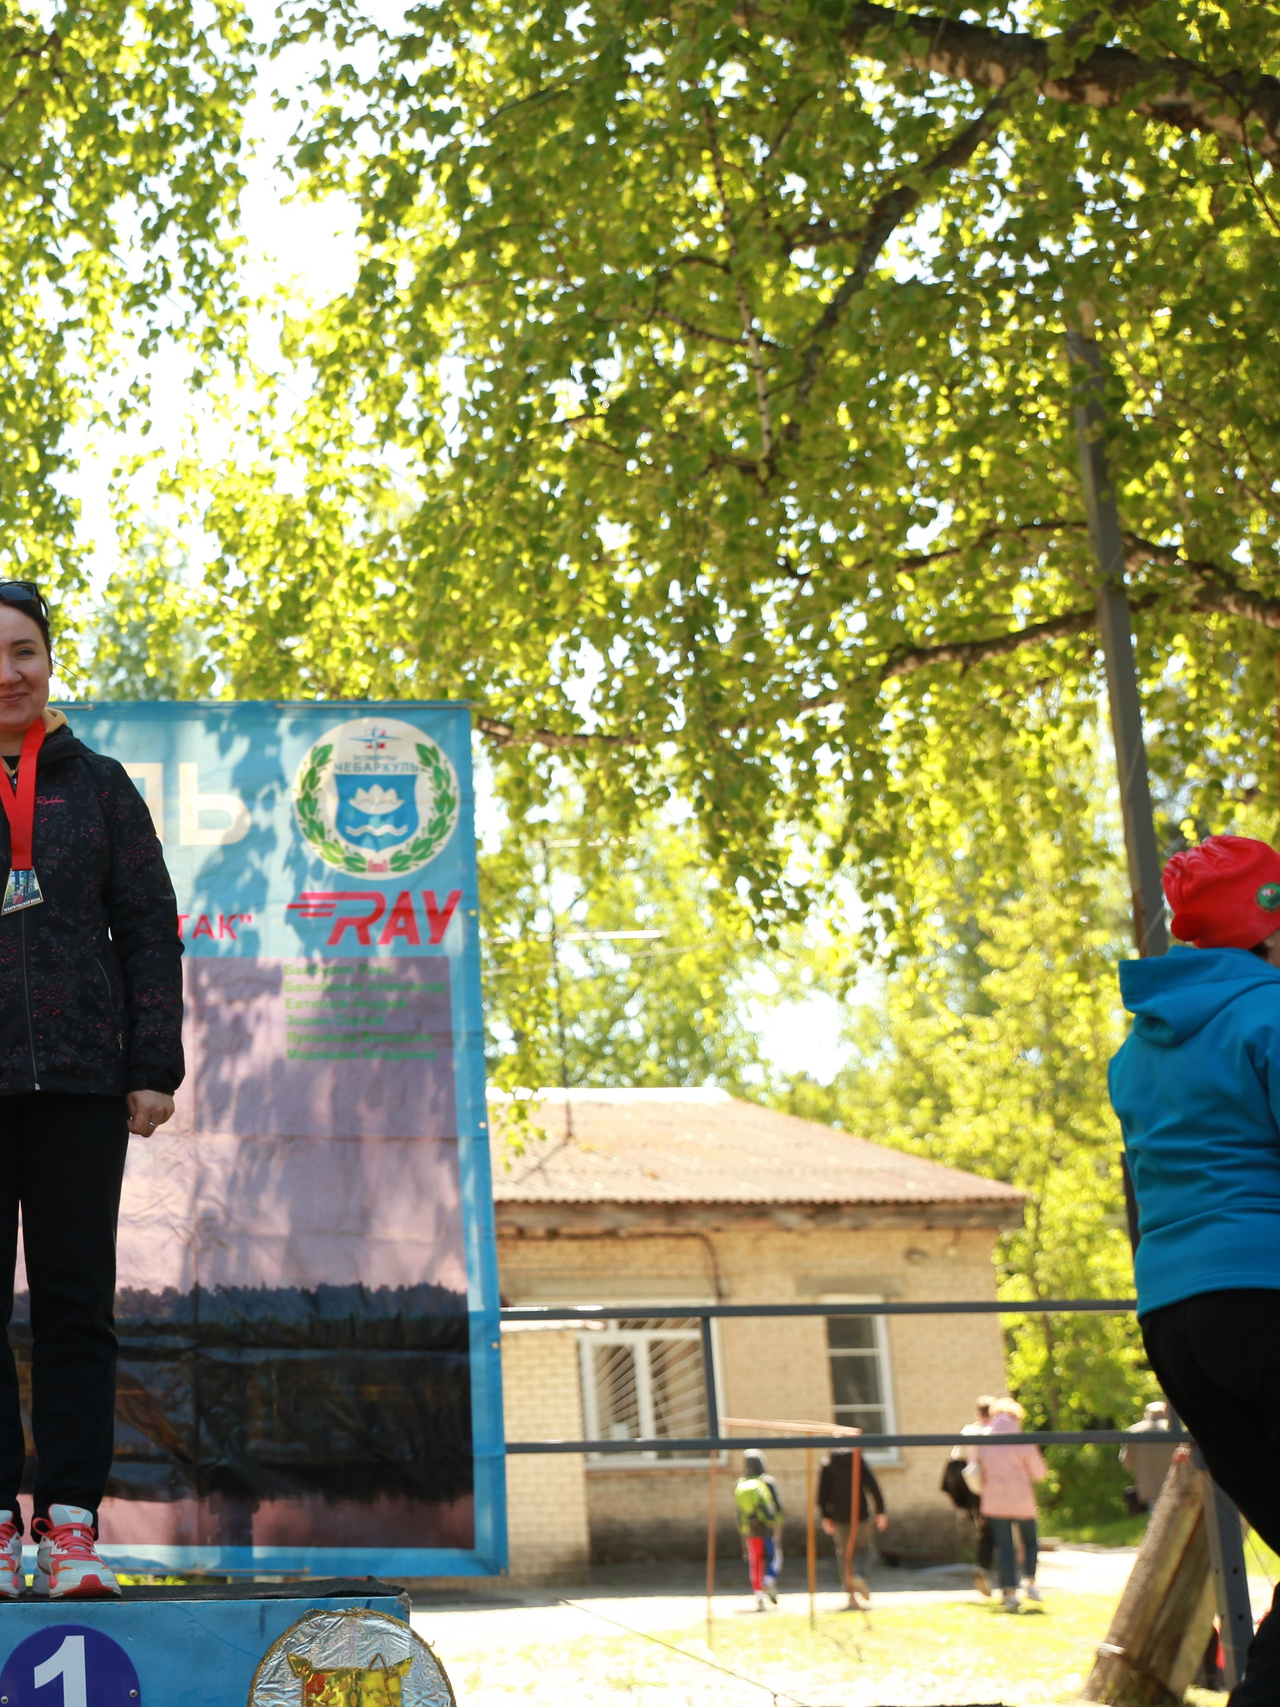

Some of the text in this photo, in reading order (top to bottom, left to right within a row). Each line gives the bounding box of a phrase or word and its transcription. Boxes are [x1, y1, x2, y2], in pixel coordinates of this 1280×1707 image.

[335, 762, 419, 773] ЧЕБАРКУЛЬ
[177, 913, 253, 940] ТАК"
[286, 890, 463, 946] RAY
[34, 1635, 87, 1707] 1
